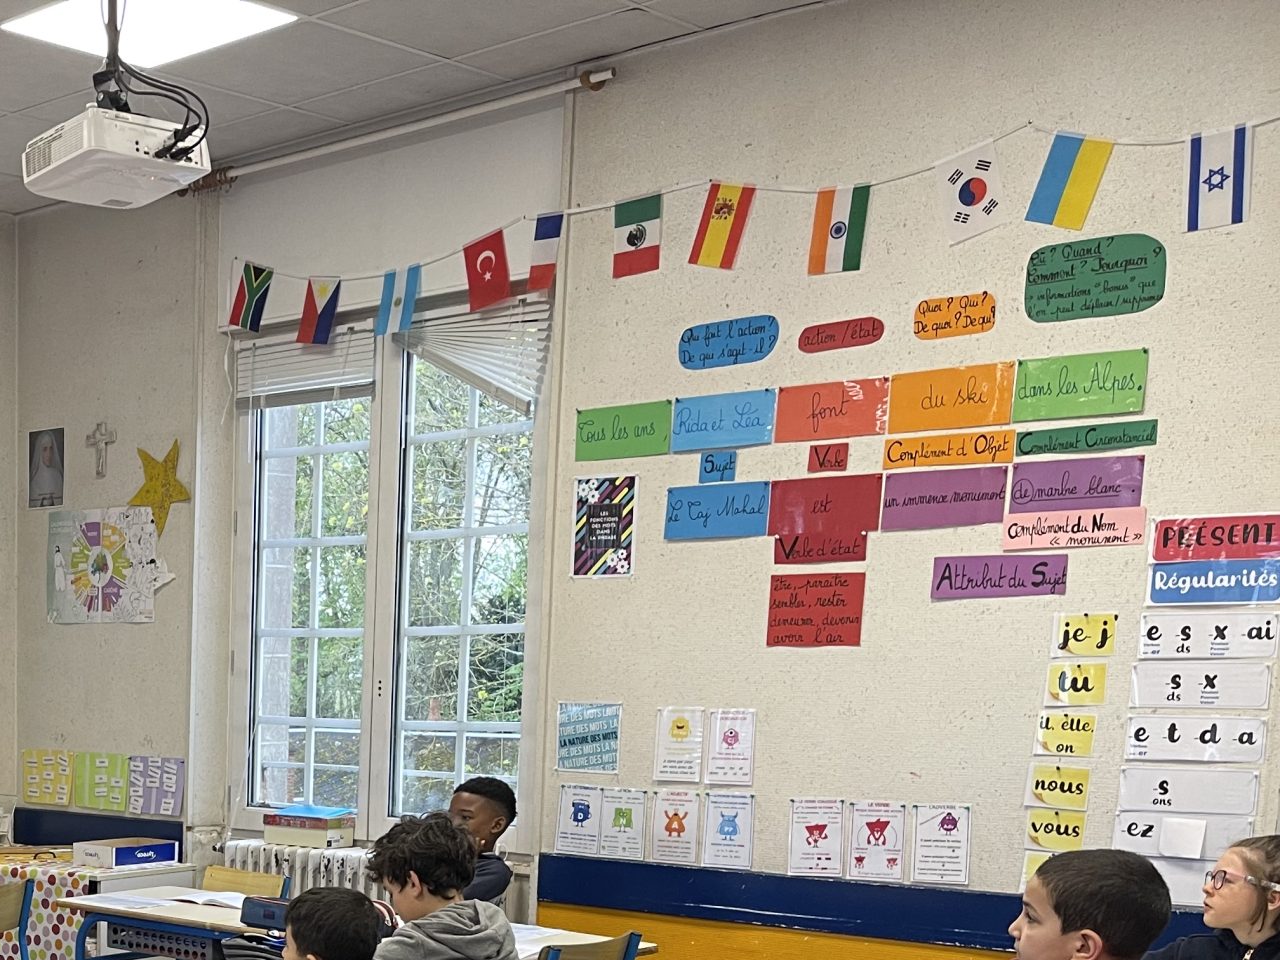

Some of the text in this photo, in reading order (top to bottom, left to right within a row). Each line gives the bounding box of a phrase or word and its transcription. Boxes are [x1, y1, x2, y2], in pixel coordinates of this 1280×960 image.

[803, 317, 880, 346] action état
[920, 375, 988, 410] du ski
[1018, 365, 1079, 400] dans les
[673, 401, 765, 436] Rida et Léa
[806, 391, 849, 433] font
[578, 414, 629, 444] Tous les
[886, 438, 952, 467] Complément
[1018, 431, 1081, 457] Complément
[703, 455, 736, 476] Sujet
[813, 446, 846, 470] Verbe
[1033, 470, 1123, 497] marbre blanc
[810, 494, 833, 516] est
[949, 488, 1007, 506] monument
[667, 495, 765, 528] Le Taj Mahal
[1006, 511, 1119, 546] Complément du Nom
[1065, 528, 1130, 546] monument
[1161, 520, 1277, 550] PRÉSENT
[778, 534, 862, 561] Verbe d'état
[935, 561, 1068, 595] Attribut du Sujet
[1154, 568, 1279, 594] Régularités
[772, 630, 805, 644] avoir
[1058, 621, 1087, 650] je
[1176, 643, 1191, 654] ds
[1058, 670, 1094, 693] tu
[1055, 742, 1075, 754] on
[1034, 778, 1084, 796] nous
[1152, 796, 1173, 807] ons
[1031, 819, 1081, 838] vous
